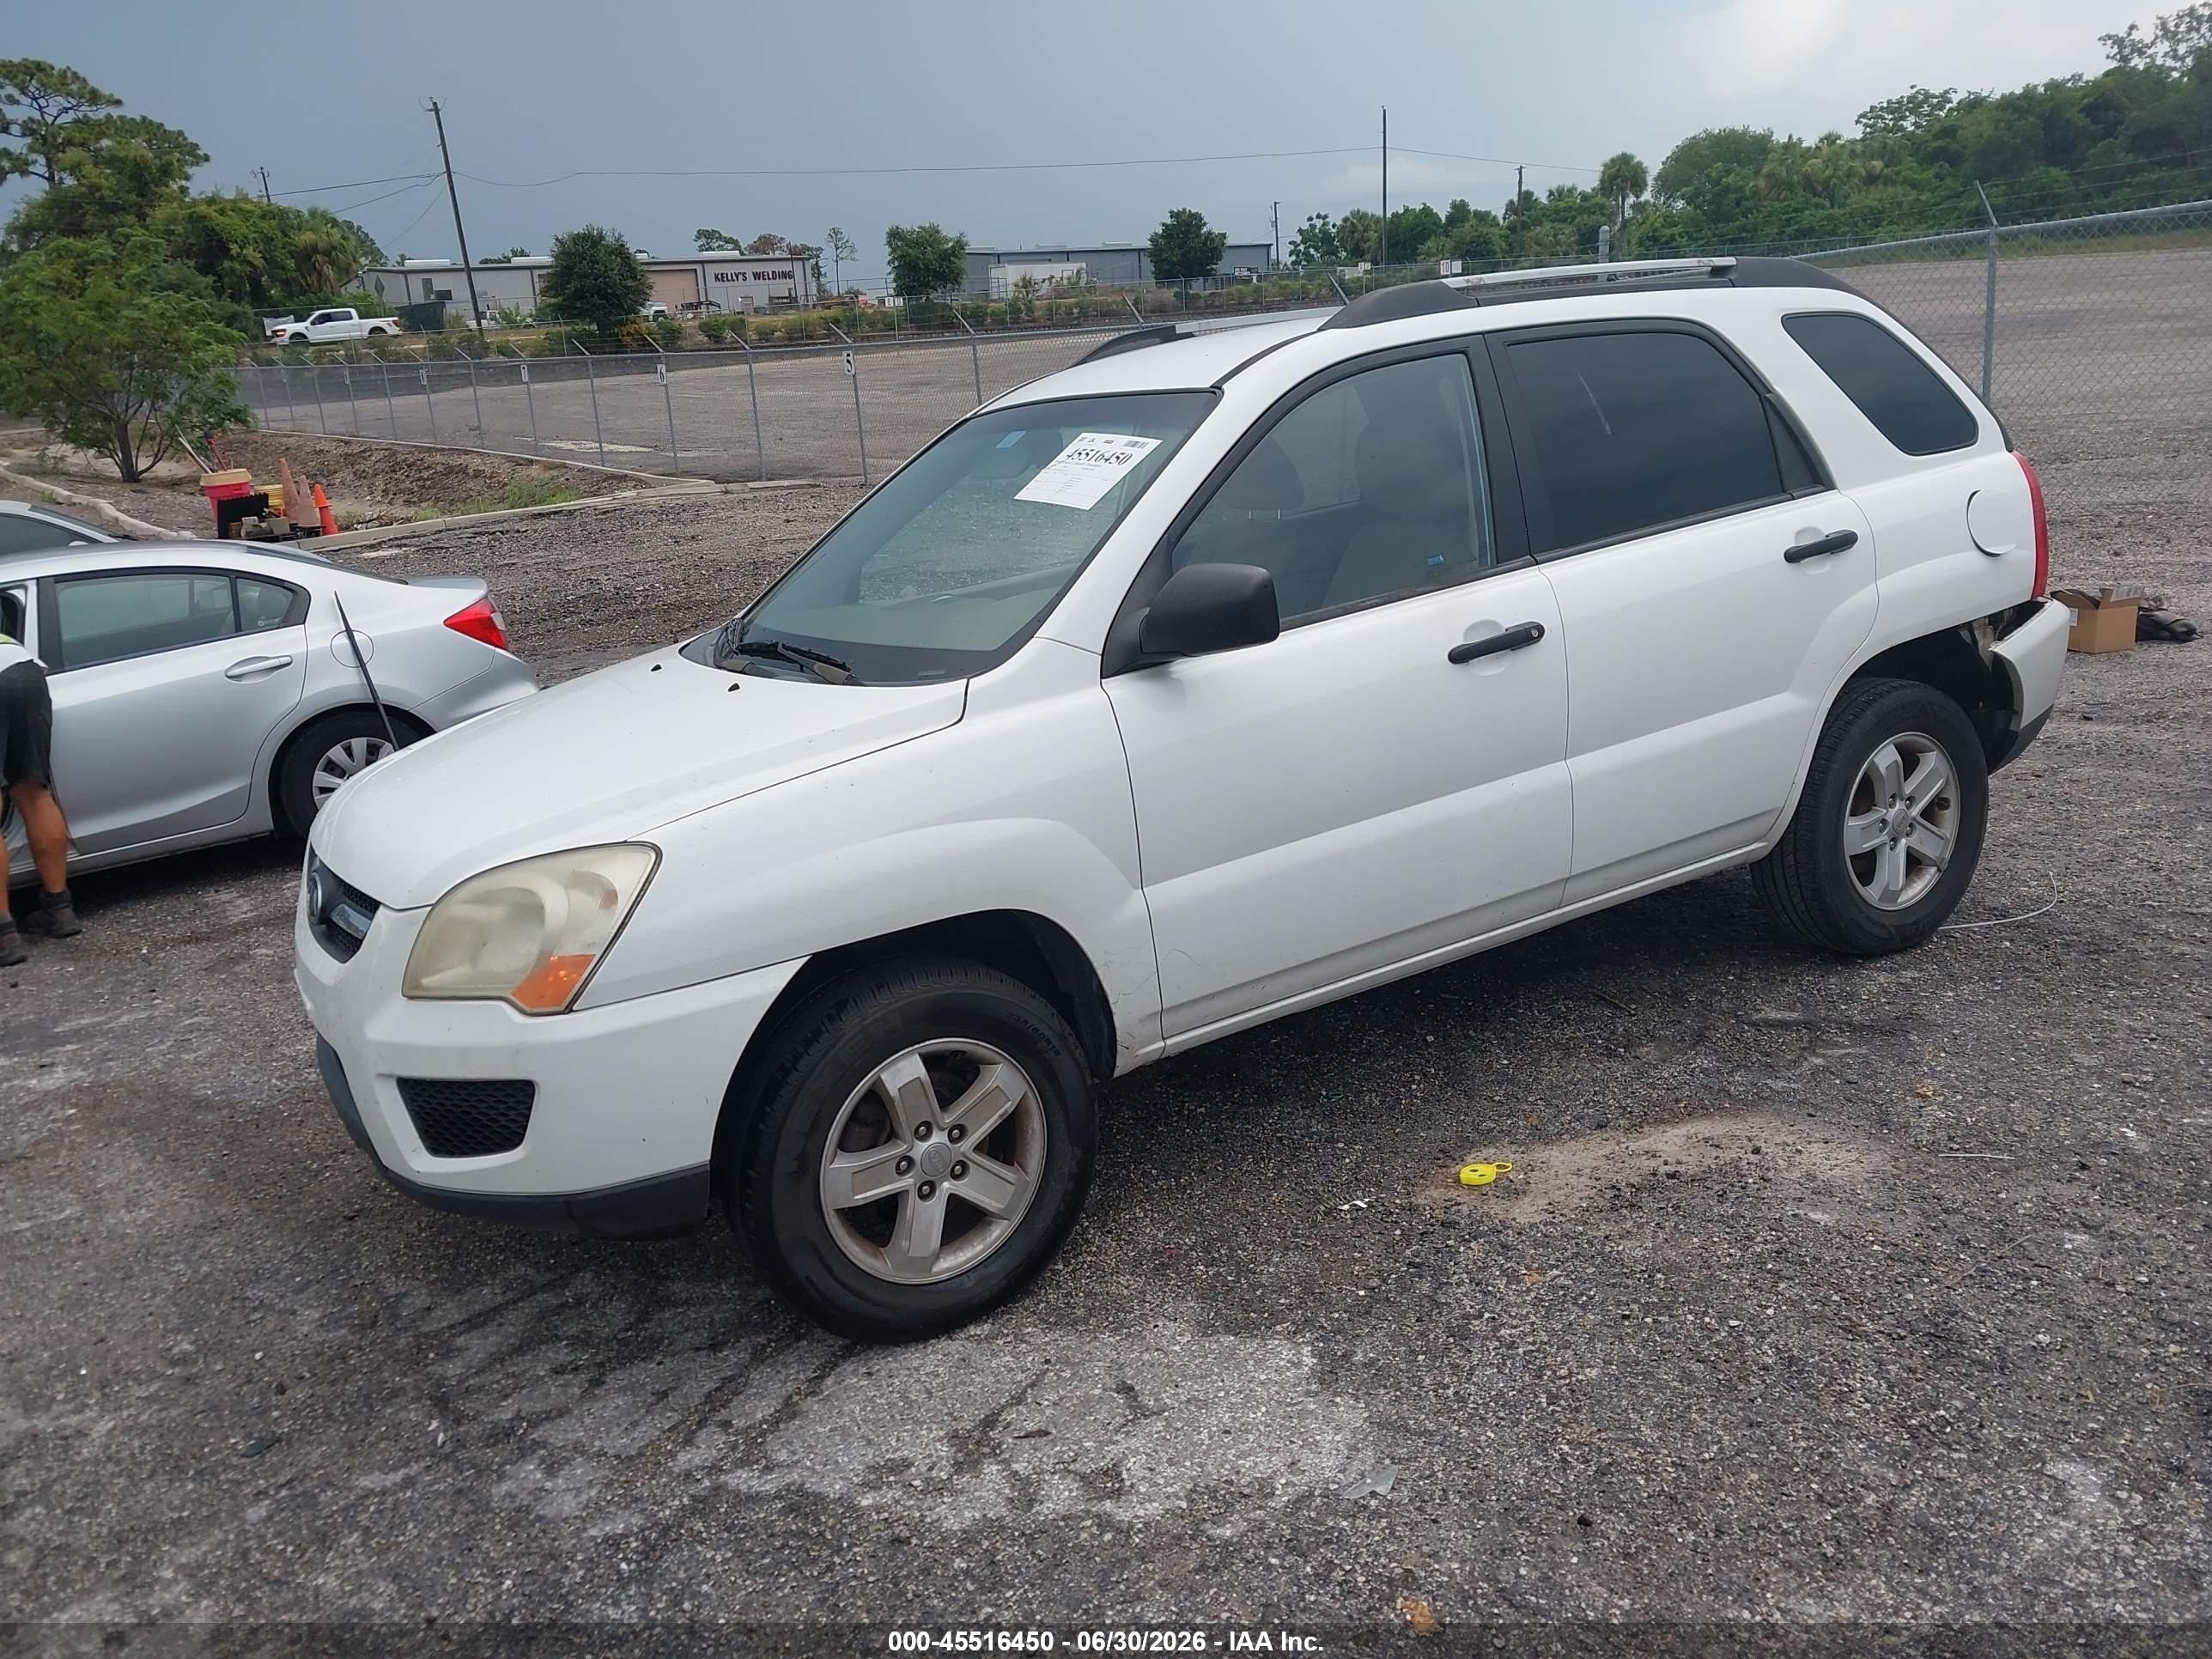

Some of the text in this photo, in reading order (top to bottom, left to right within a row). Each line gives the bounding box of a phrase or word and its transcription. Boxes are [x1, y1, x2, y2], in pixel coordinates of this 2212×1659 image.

[714, 270, 793, 283] KELLY'S WELDING
[846, 353, 853, 373] 5
[659, 365, 665, 383] 6
[1066, 447, 1133, 466] 45516450
